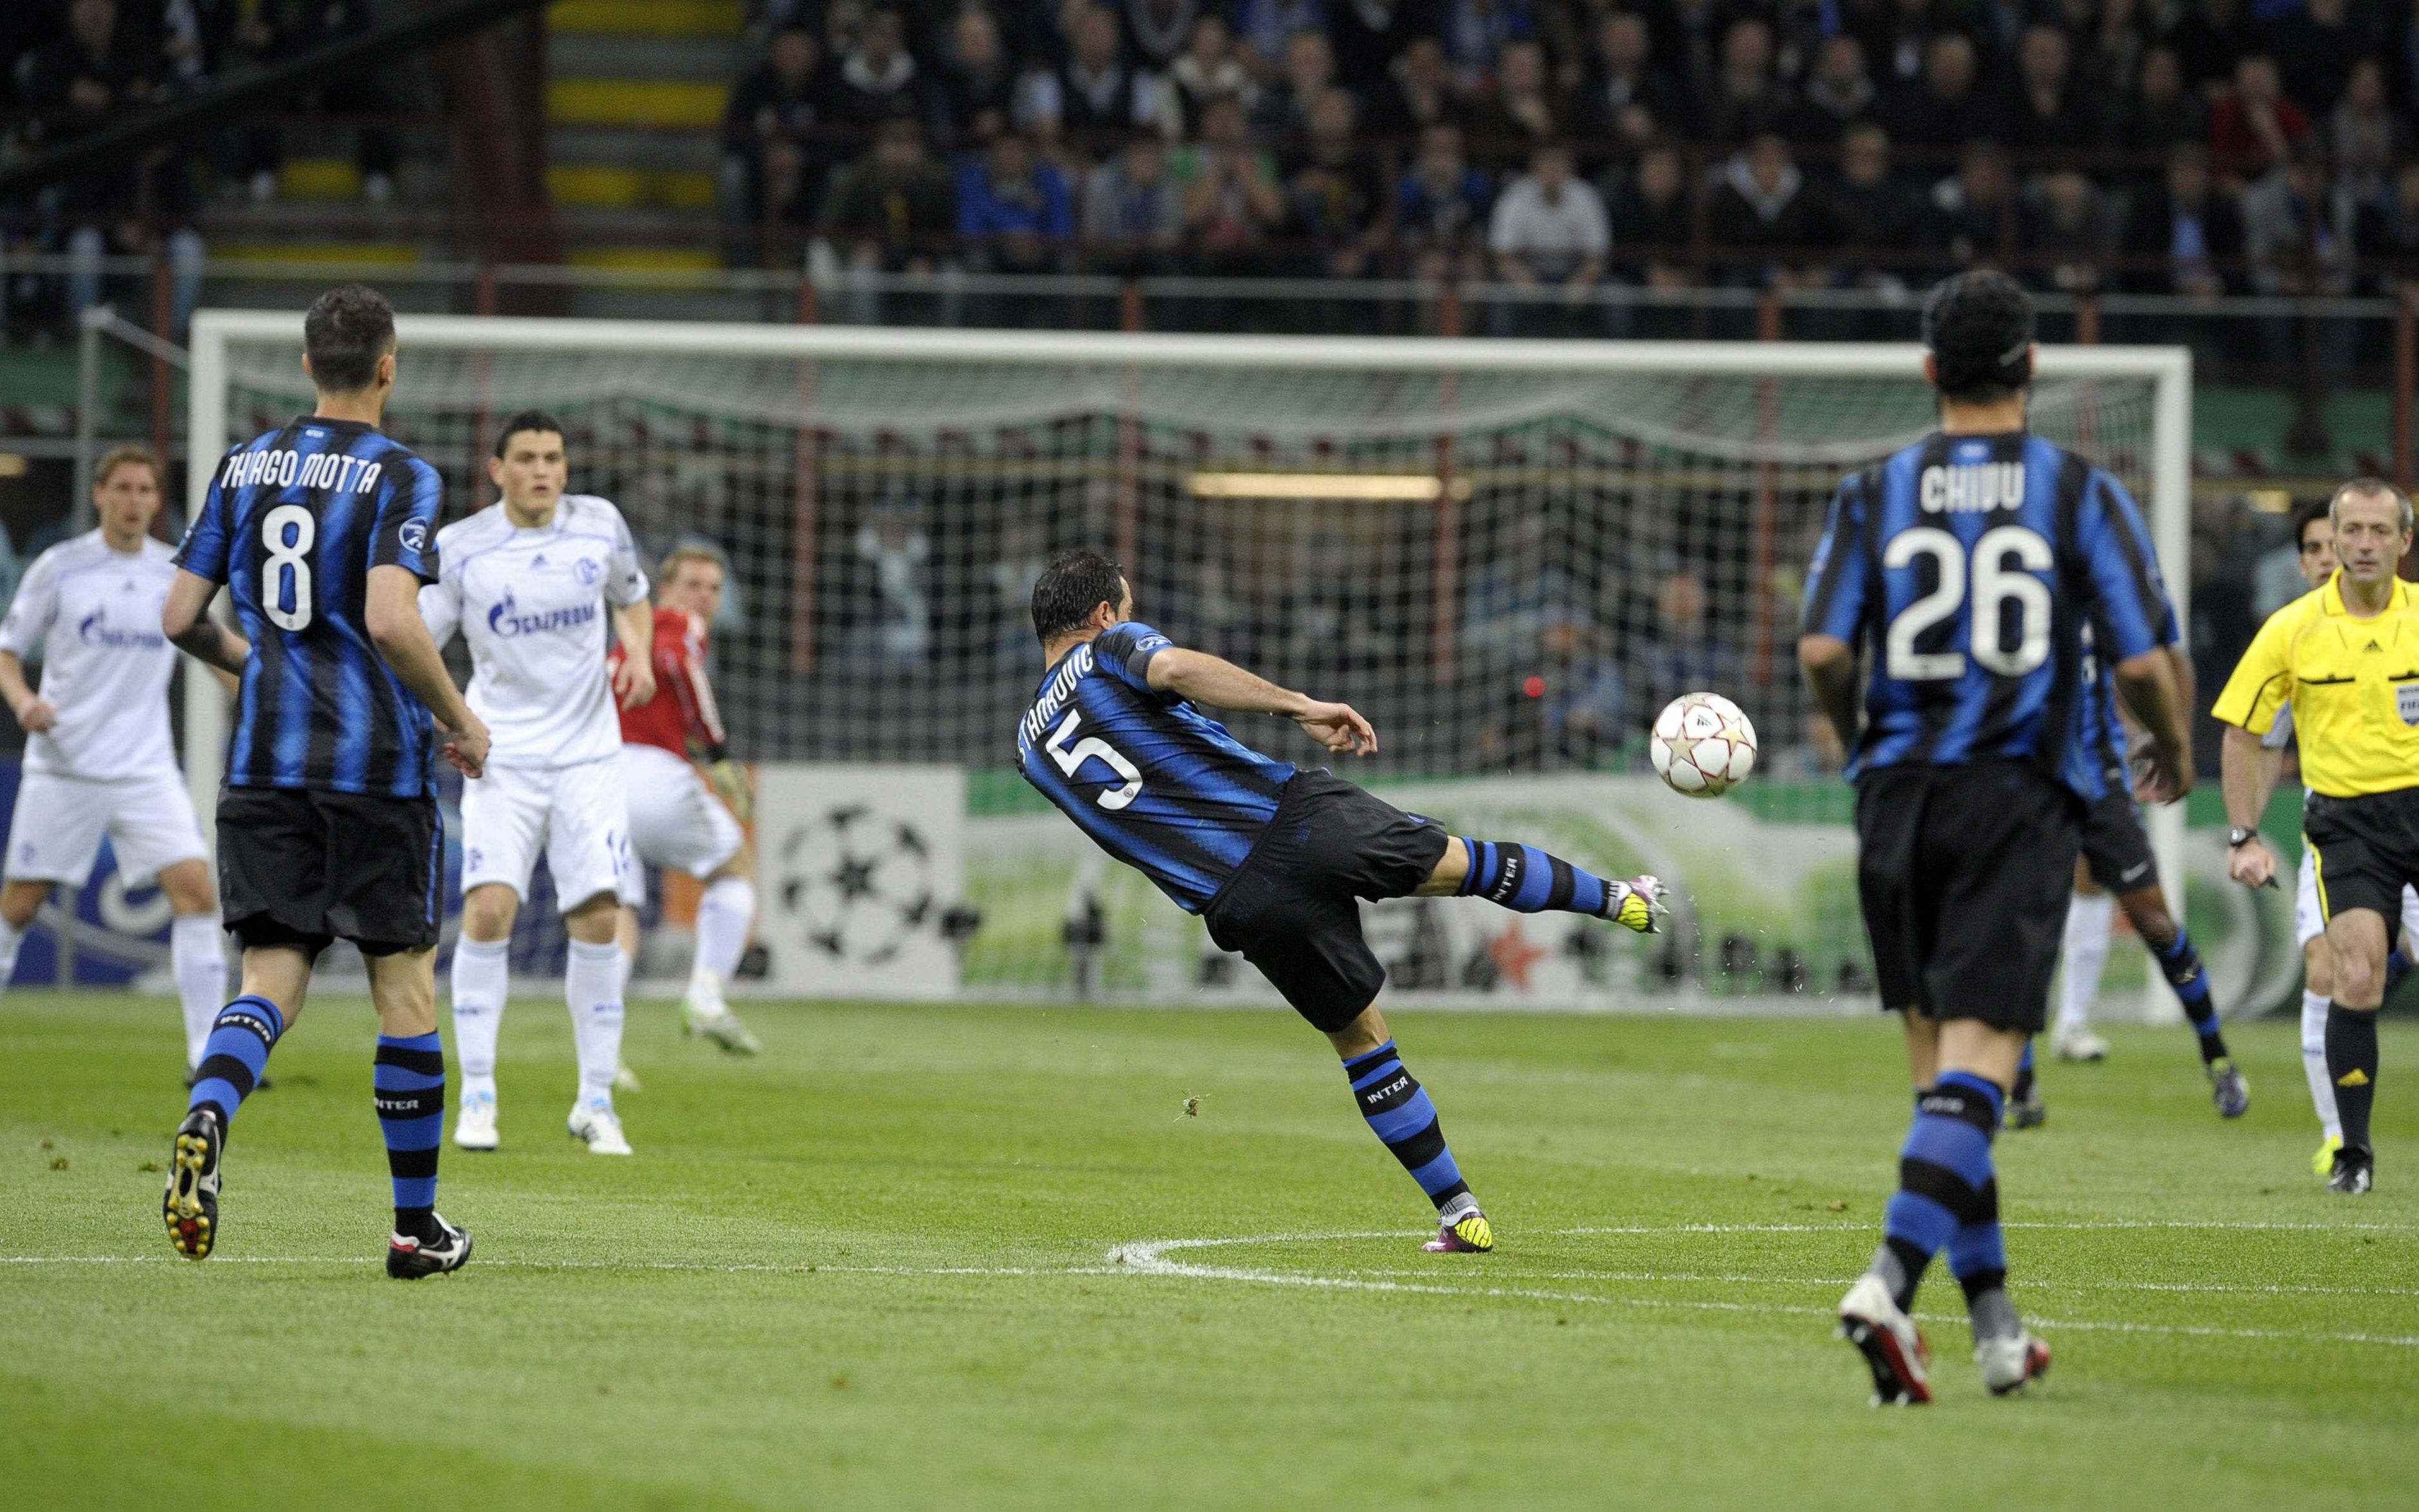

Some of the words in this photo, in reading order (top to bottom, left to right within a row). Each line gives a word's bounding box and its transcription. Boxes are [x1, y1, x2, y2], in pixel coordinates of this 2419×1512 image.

[220, 449, 299, 489] THIAGO
[296, 453, 383, 494] MOTTA
[262, 505, 315, 631] 8
[1884, 525, 2053, 681] 26
[2400, 699, 2419, 712] FIF
[1045, 708, 1143, 810] 5
[1491, 857, 1518, 901] INTER
[373, 1096, 419, 1110] NTER
[1367, 1076, 1408, 1104] INTER
